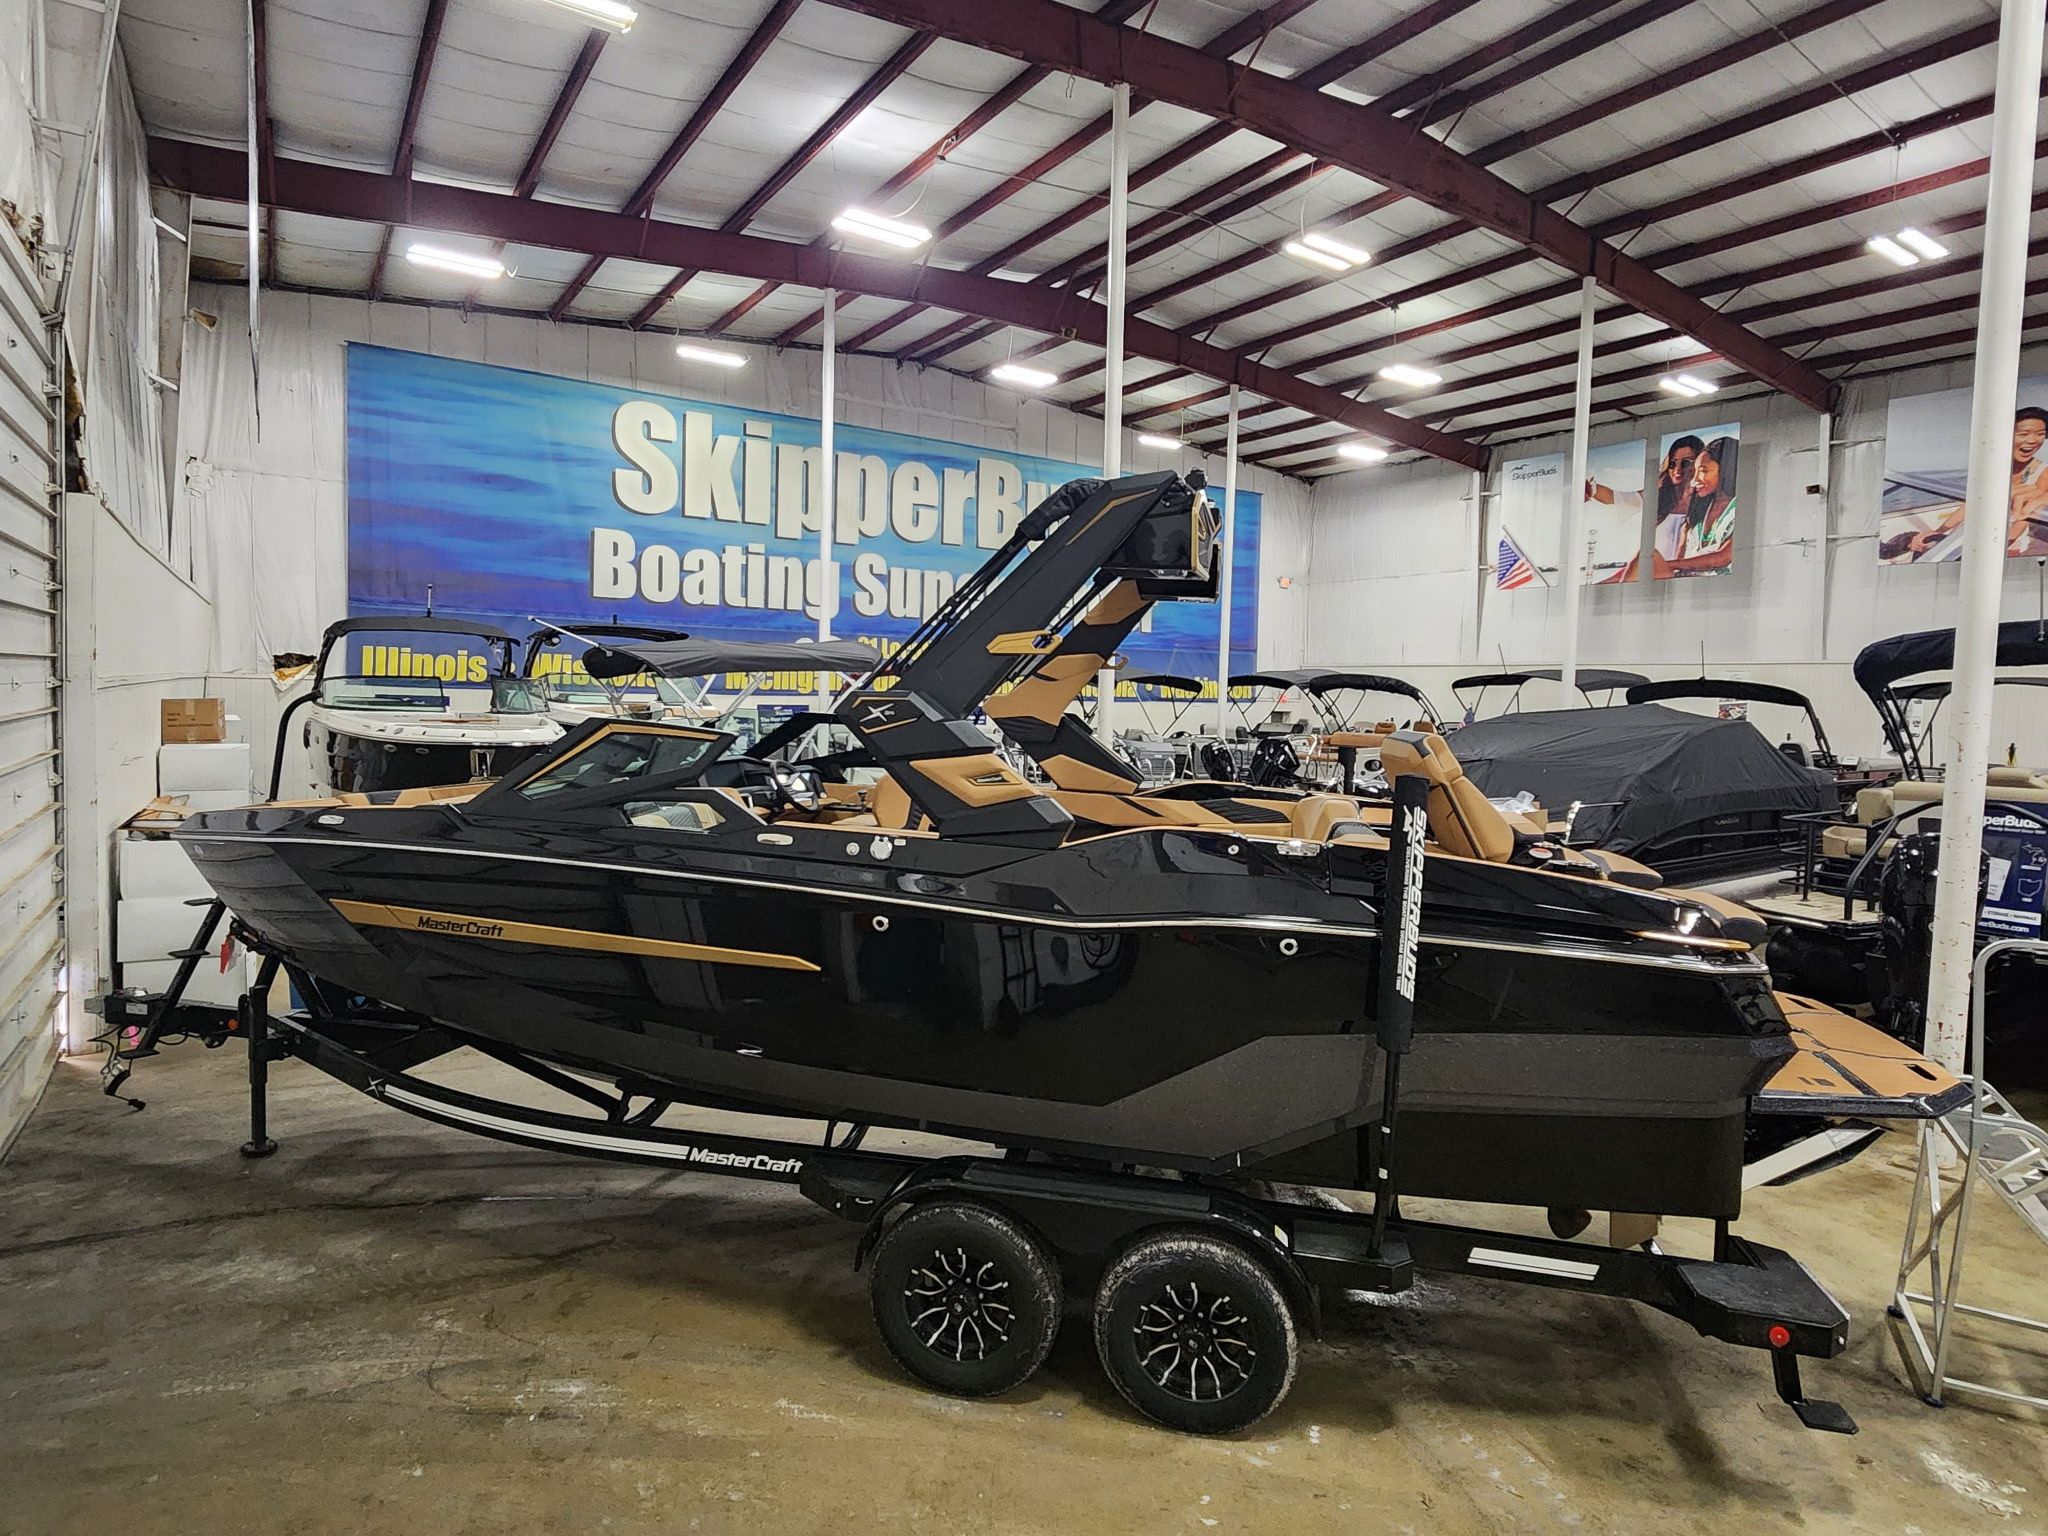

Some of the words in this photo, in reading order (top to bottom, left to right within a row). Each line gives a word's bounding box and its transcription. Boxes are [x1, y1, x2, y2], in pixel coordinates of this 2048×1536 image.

[591, 527, 840, 621] Boating
[361, 646, 488, 683] Illinois
[1404, 806, 1428, 1002] SKIPPERBUD'S
[417, 915, 504, 937] MasterCraft
[688, 1147, 803, 1174] MasterCraft
